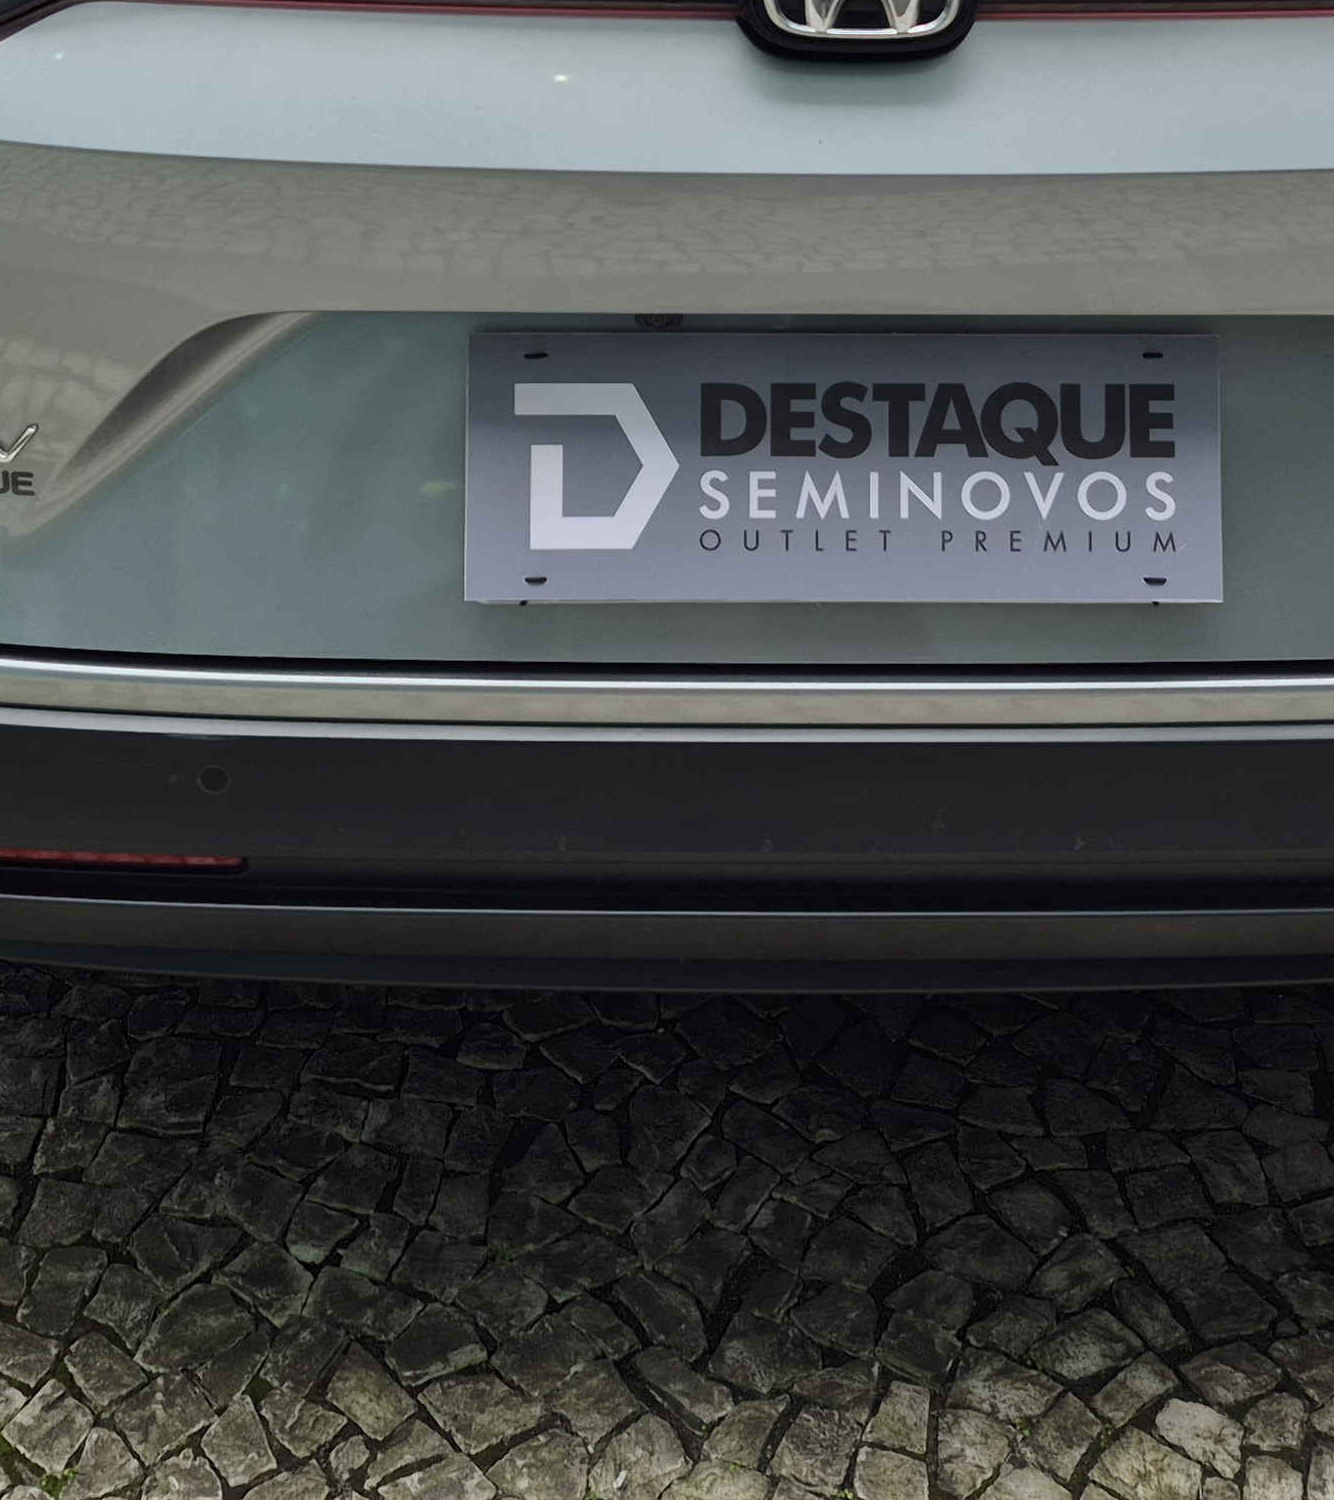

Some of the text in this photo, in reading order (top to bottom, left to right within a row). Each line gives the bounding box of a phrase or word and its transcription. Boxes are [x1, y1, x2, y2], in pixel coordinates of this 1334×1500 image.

[700, 381, 1175, 465] DESTAQUE
[699, 468, 1177, 521] SEMINOVOS
[700, 529, 1177, 553] OUTLET PREMIUM
